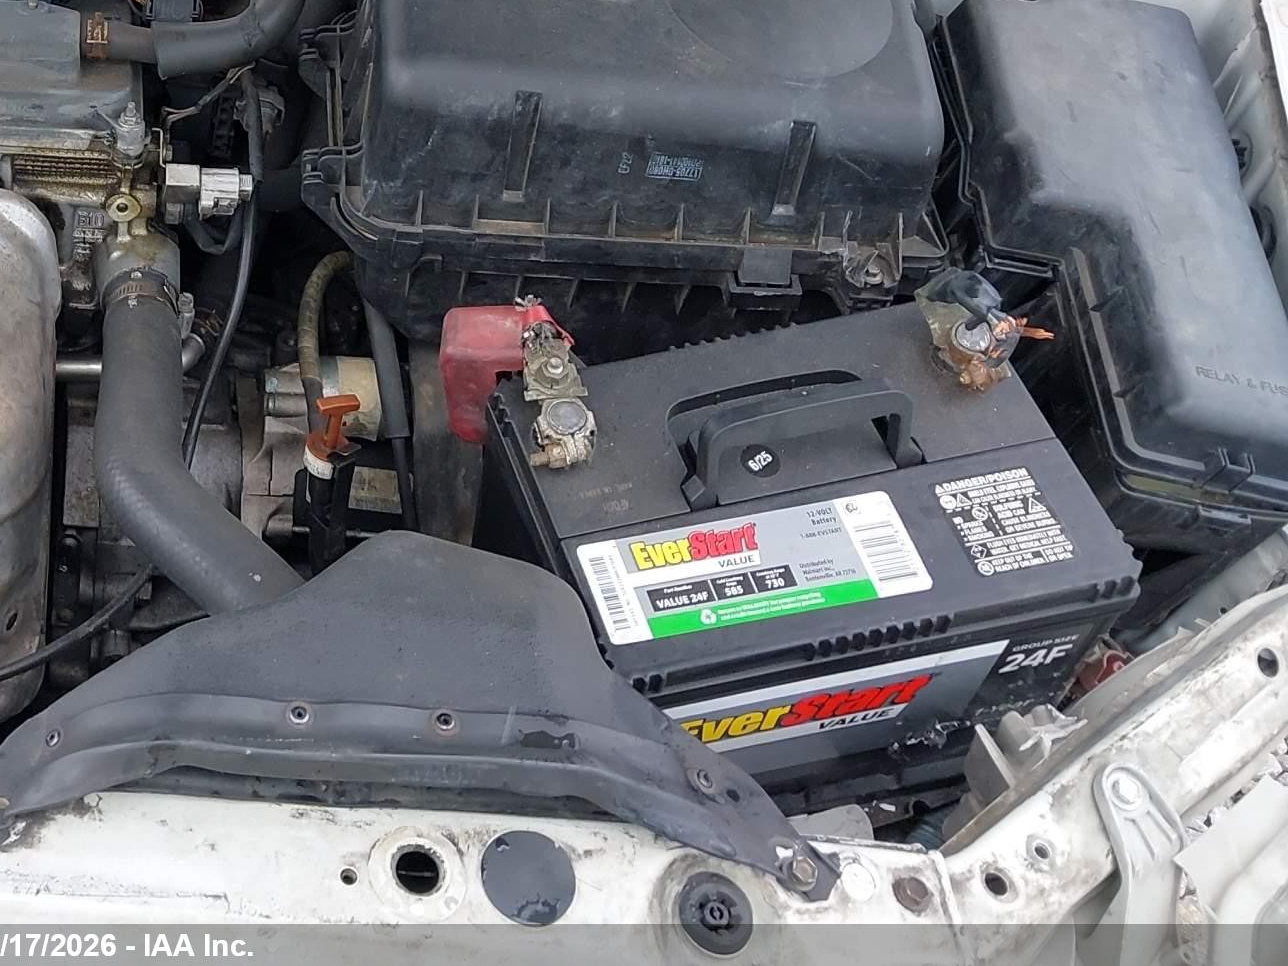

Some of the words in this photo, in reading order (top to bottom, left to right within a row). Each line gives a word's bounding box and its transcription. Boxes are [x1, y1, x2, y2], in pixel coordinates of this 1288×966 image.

[1195, 366, 1240, 385] RELAY
[748, 450, 773, 471] 6/25
[942, 467, 1029, 492] DANGER/POISON
[811, 517, 837, 526] Battery
[630, 522, 759, 571] EverStart
[718, 555, 755, 568] VALUE
[724, 585, 743, 597] 585
[765, 577, 785, 589] 730
[655, 594, 689, 609] VALUE
[690, 591, 708, 603] 24F
[1012, 640, 1053, 652] GROUP
[998, 643, 1073, 674] 24F
[819, 707, 898, 730] VALUE
